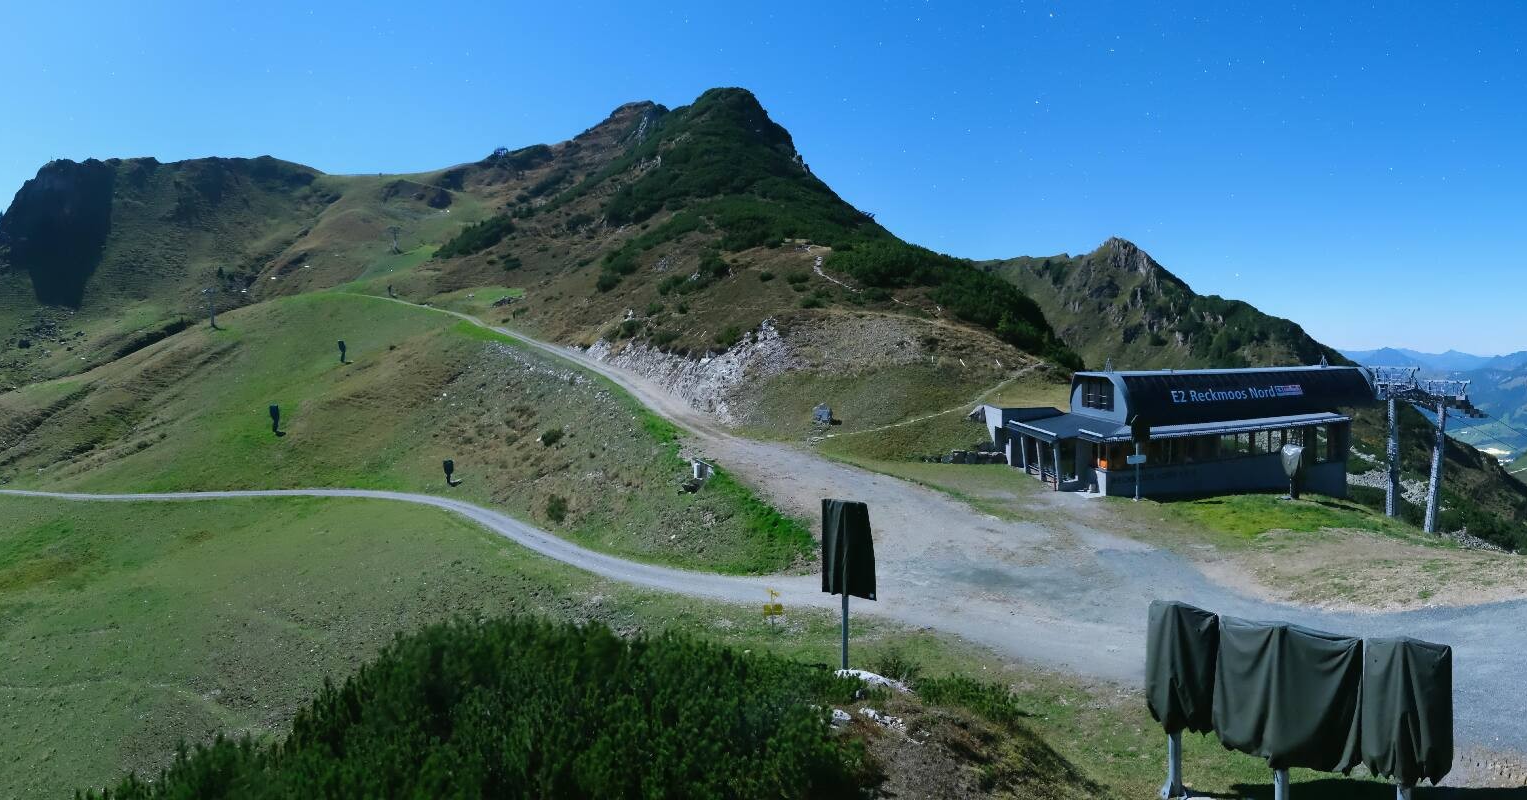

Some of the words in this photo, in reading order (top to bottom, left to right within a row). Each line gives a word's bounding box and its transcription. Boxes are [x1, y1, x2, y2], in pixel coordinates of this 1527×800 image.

[1170, 390, 1187, 403] E2
[1189, 388, 1248, 402] Reckmoos
[1248, 385, 1276, 399] Nord
